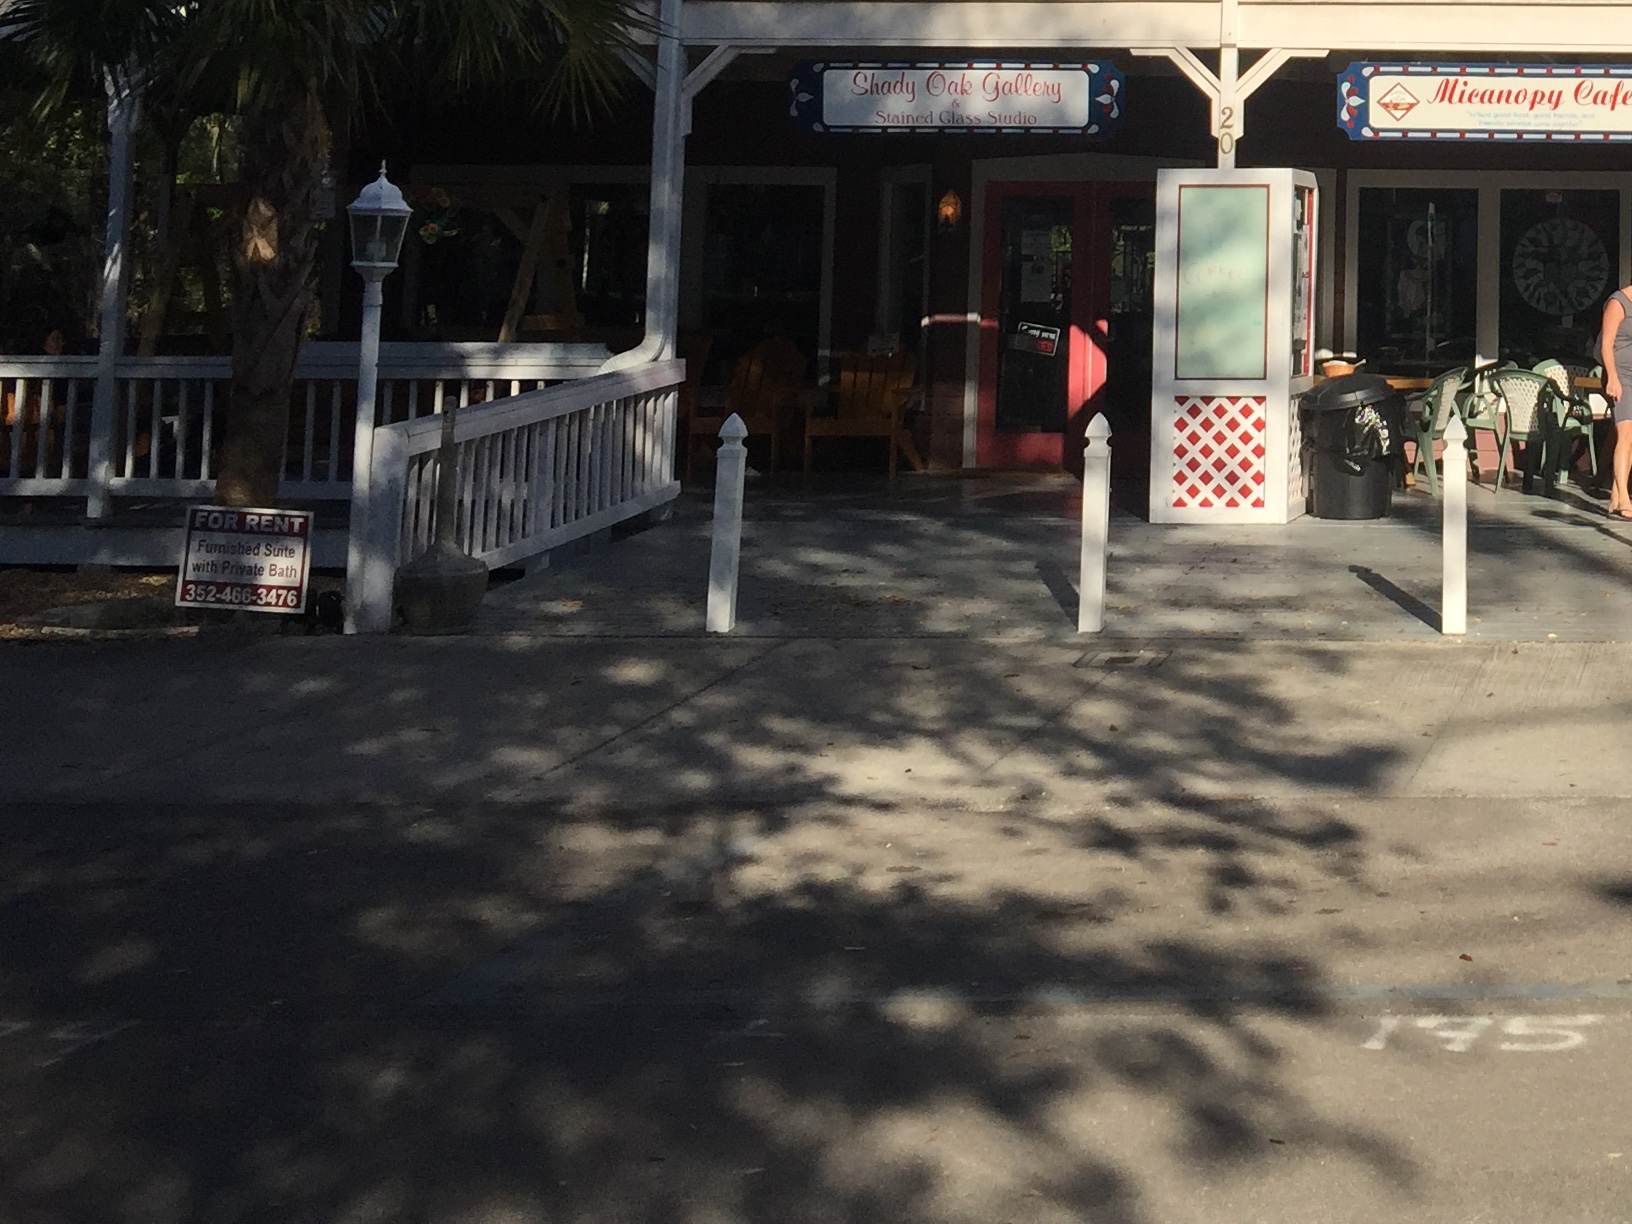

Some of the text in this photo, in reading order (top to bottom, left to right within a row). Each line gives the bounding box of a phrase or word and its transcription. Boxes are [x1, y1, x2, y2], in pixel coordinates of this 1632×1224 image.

[851, 70, 1062, 104] Shady Oak Gallery
[1426, 78, 1565, 112] Micanopy
[951, 97, 961, 109] &
[875, 109, 1037, 125] Stained Glass Studio
[194, 511, 304, 533] FOR RENT
[196, 539, 296, 559] Furnished Suite
[191, 559, 297, 579] with Private Bath
[184, 584, 298, 607] 352-466-3476
